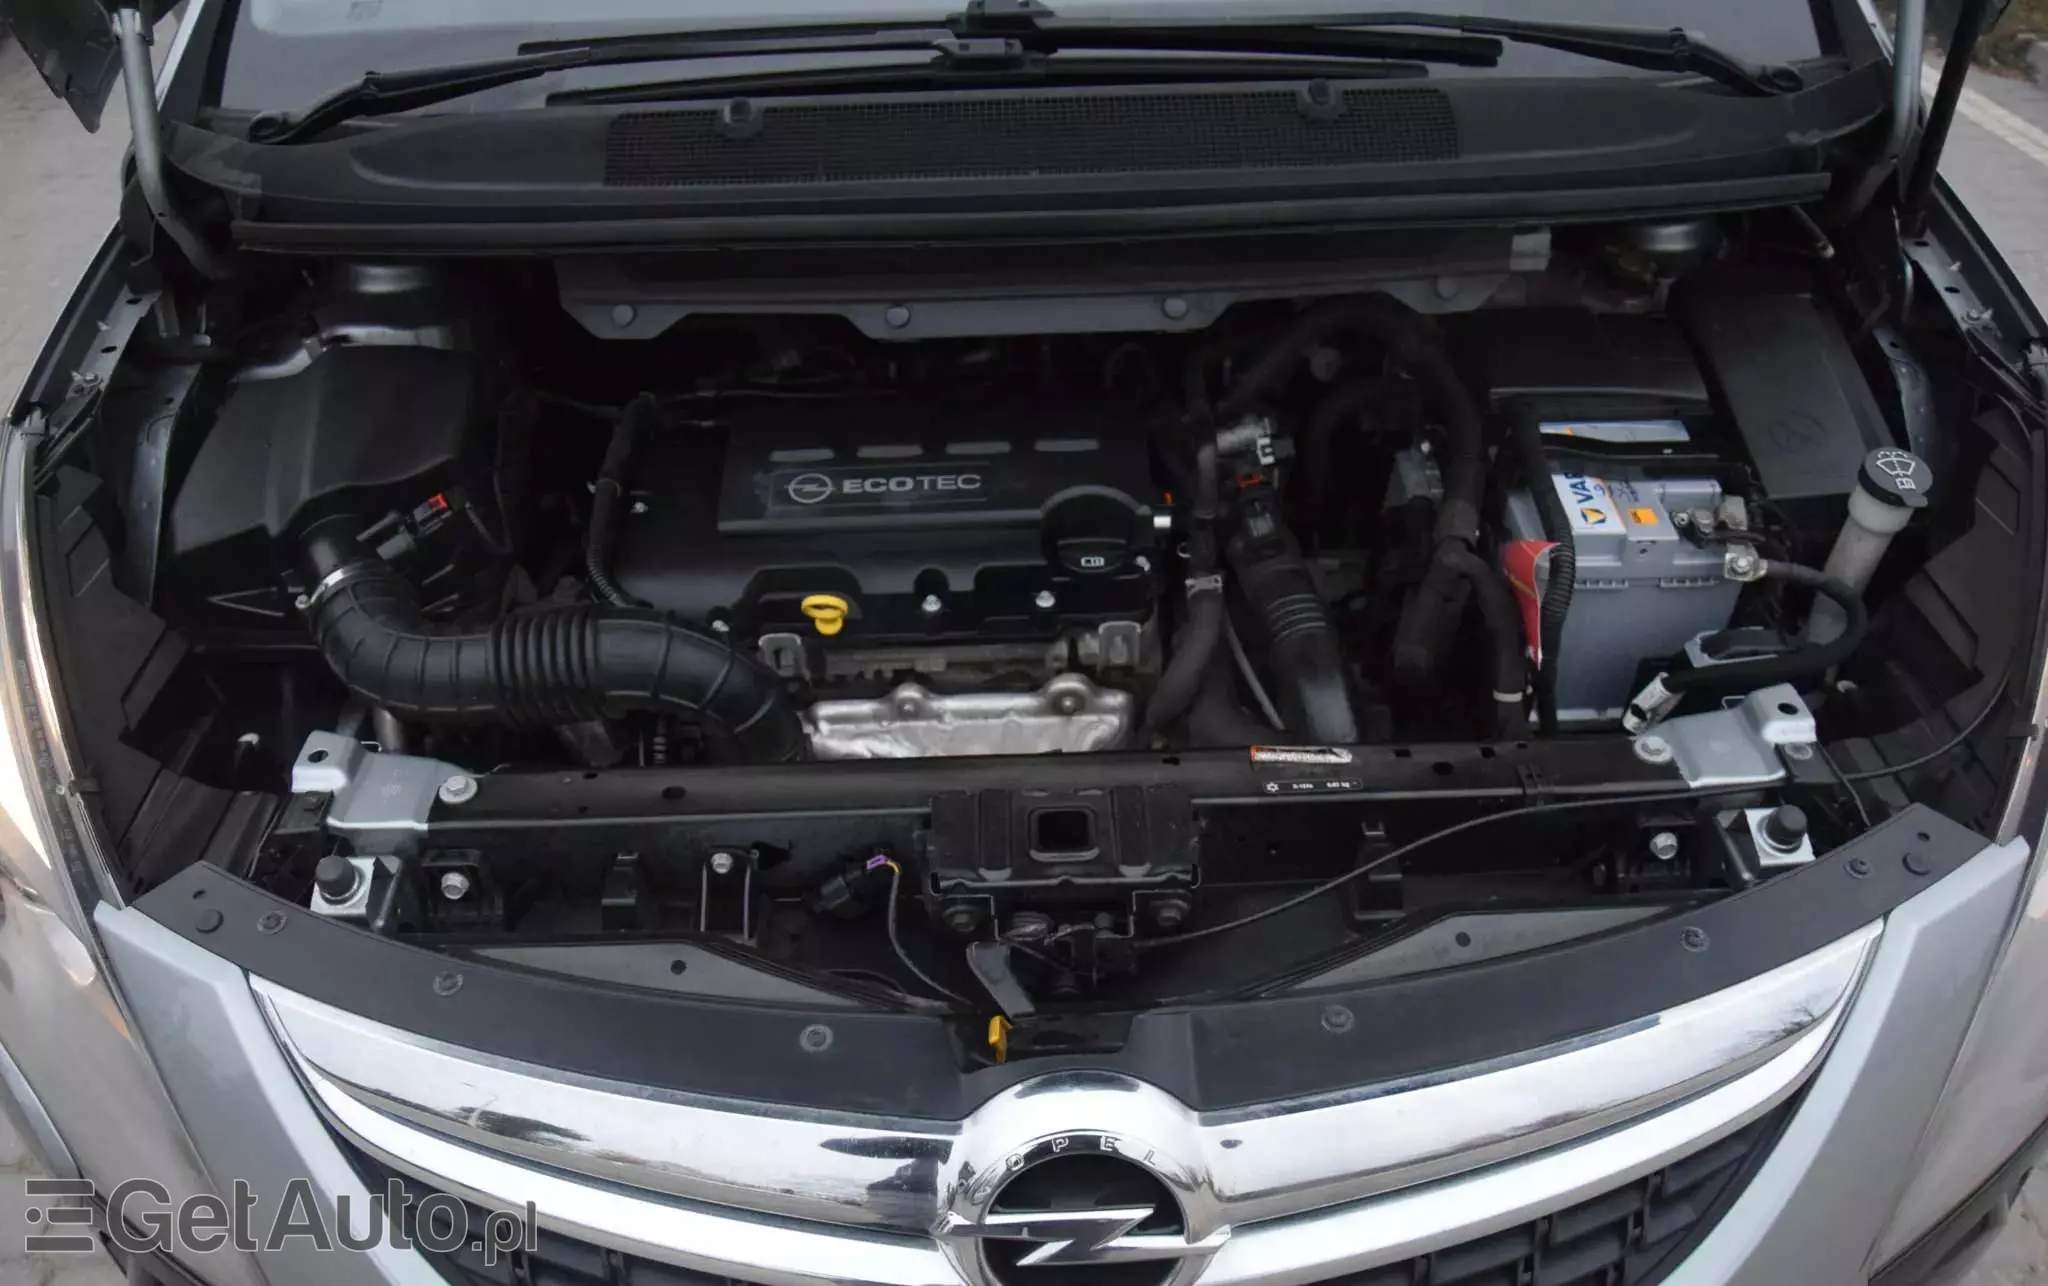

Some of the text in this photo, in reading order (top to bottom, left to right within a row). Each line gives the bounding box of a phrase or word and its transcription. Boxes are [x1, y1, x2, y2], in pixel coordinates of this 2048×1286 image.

[842, 474, 981, 494] ECOTEC
[1564, 471, 1594, 504] VAR
[1005, 1135, 1156, 1171] OPEL
